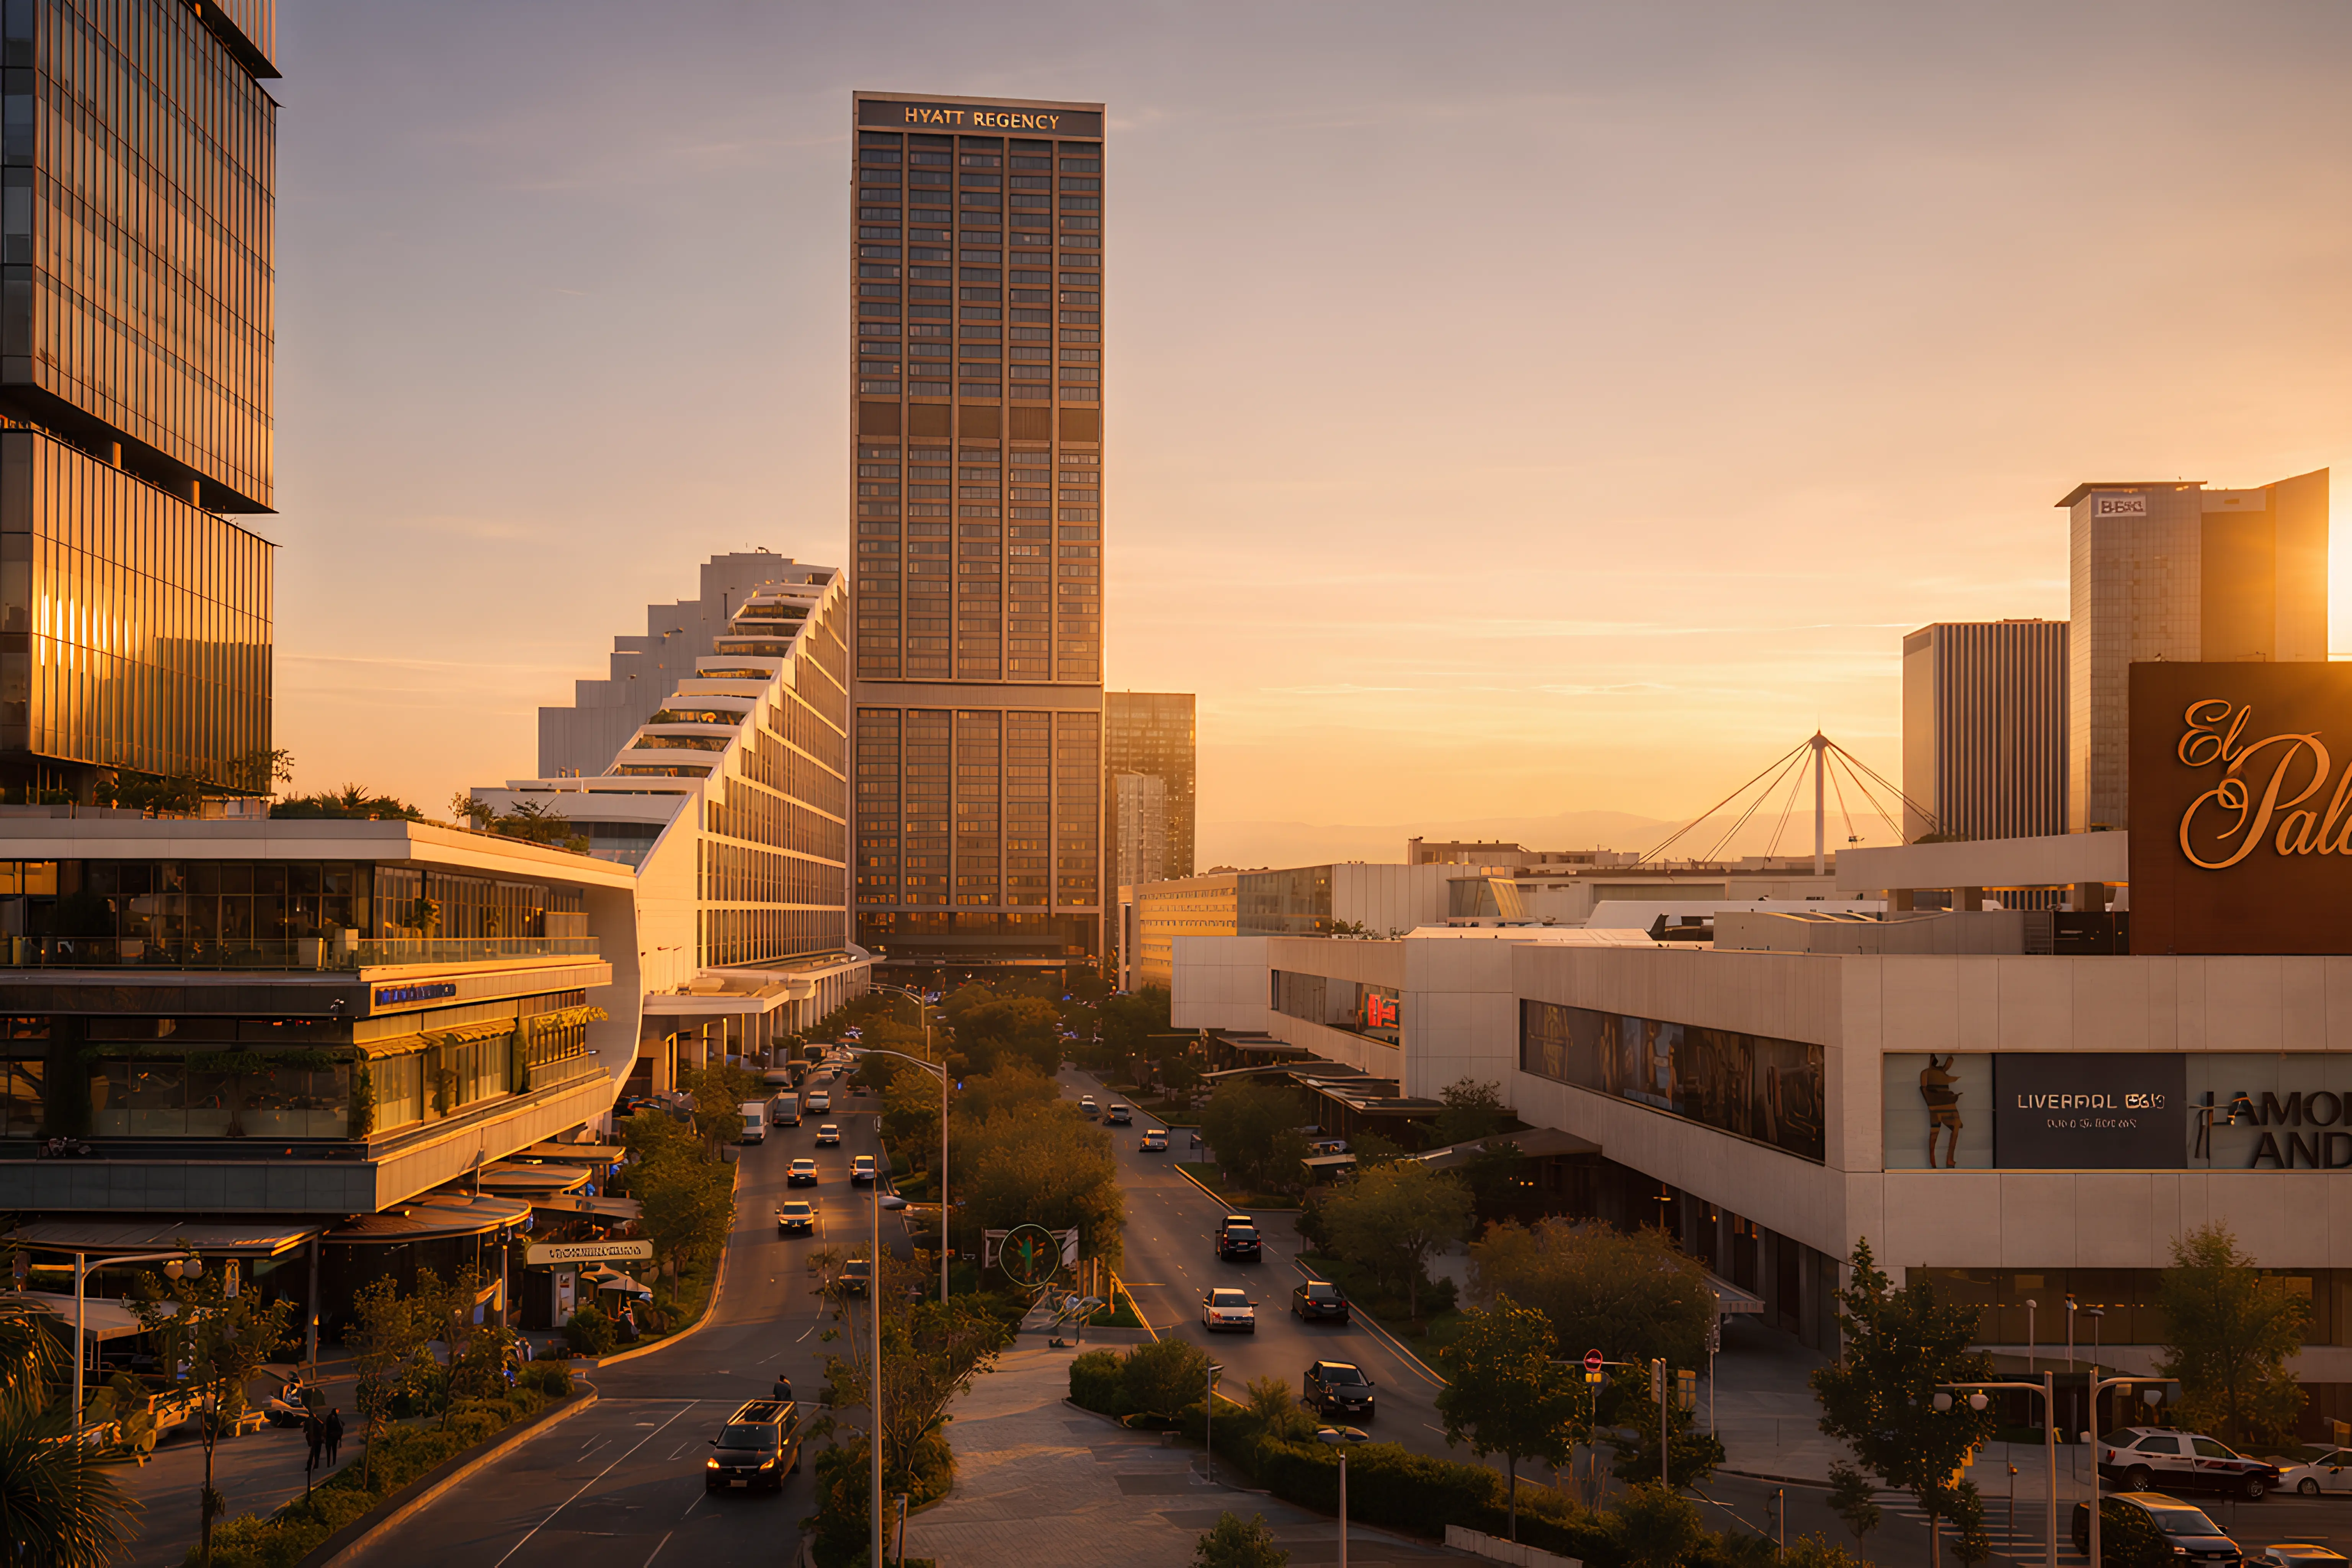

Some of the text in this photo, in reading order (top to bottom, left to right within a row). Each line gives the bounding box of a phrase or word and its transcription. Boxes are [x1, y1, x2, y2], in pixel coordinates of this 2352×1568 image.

[905, 107, 1060, 130] HYATT REGENCY
[2178, 699, 2251, 766] El
[2252, 1132, 2352, 1169] AND
